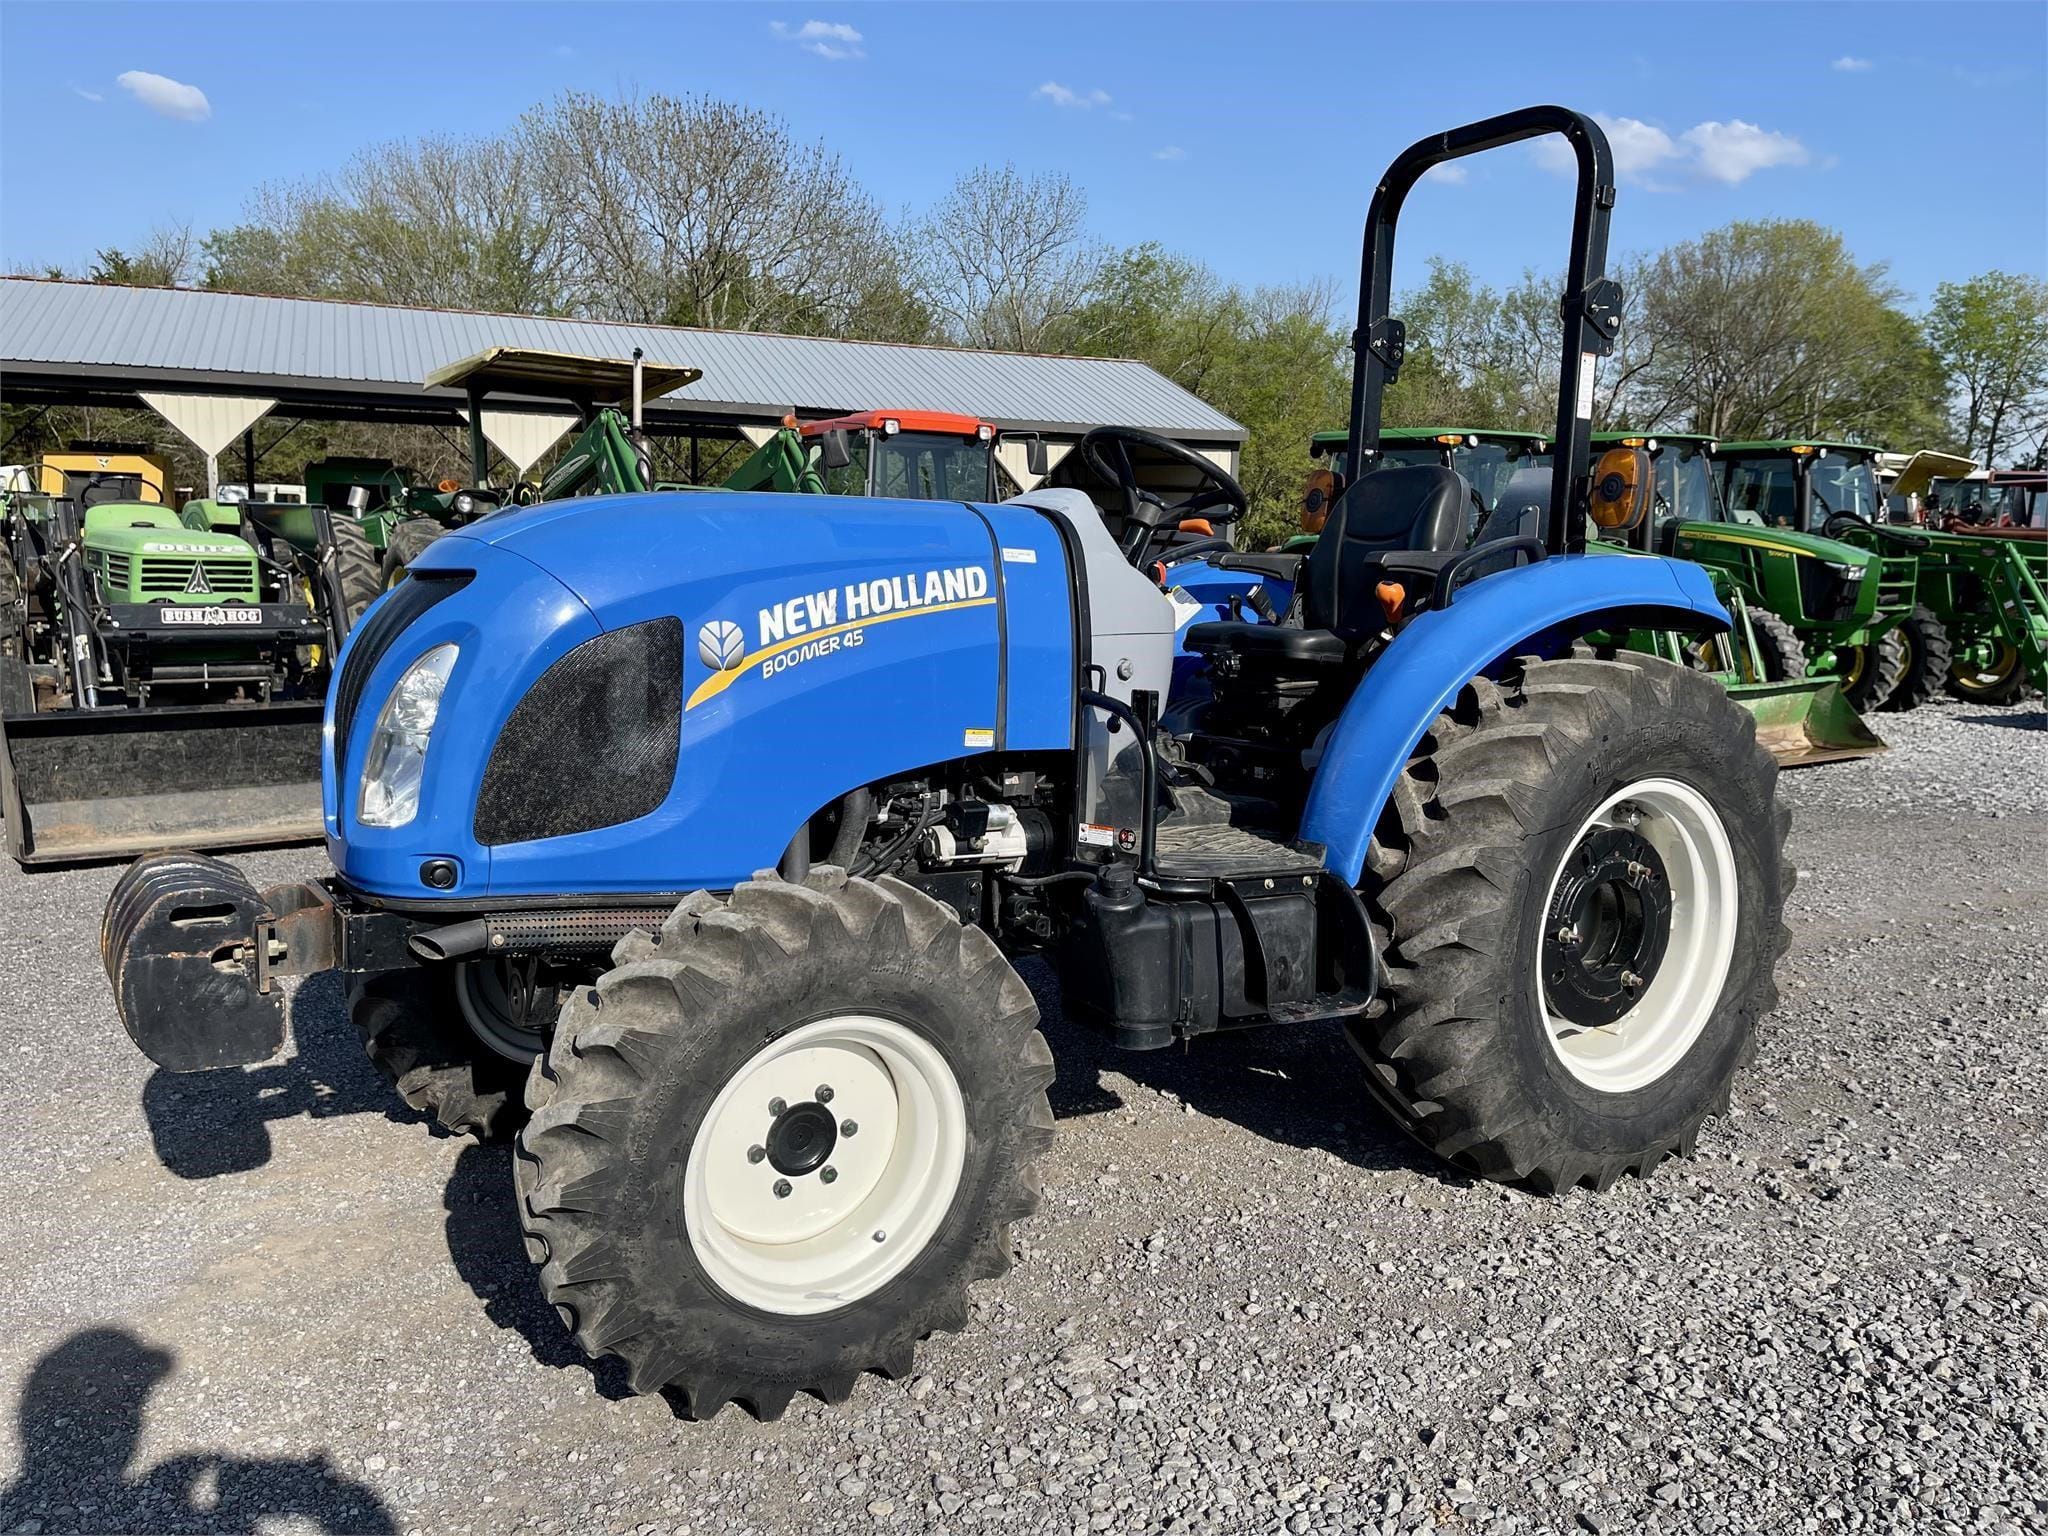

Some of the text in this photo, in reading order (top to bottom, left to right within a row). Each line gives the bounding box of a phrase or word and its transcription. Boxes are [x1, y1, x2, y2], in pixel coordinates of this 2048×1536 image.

[164, 610, 259, 622] BUSH HOG
[759, 566, 988, 647] NEW HOLLAND
[761, 629, 864, 680] BOOMER 45
